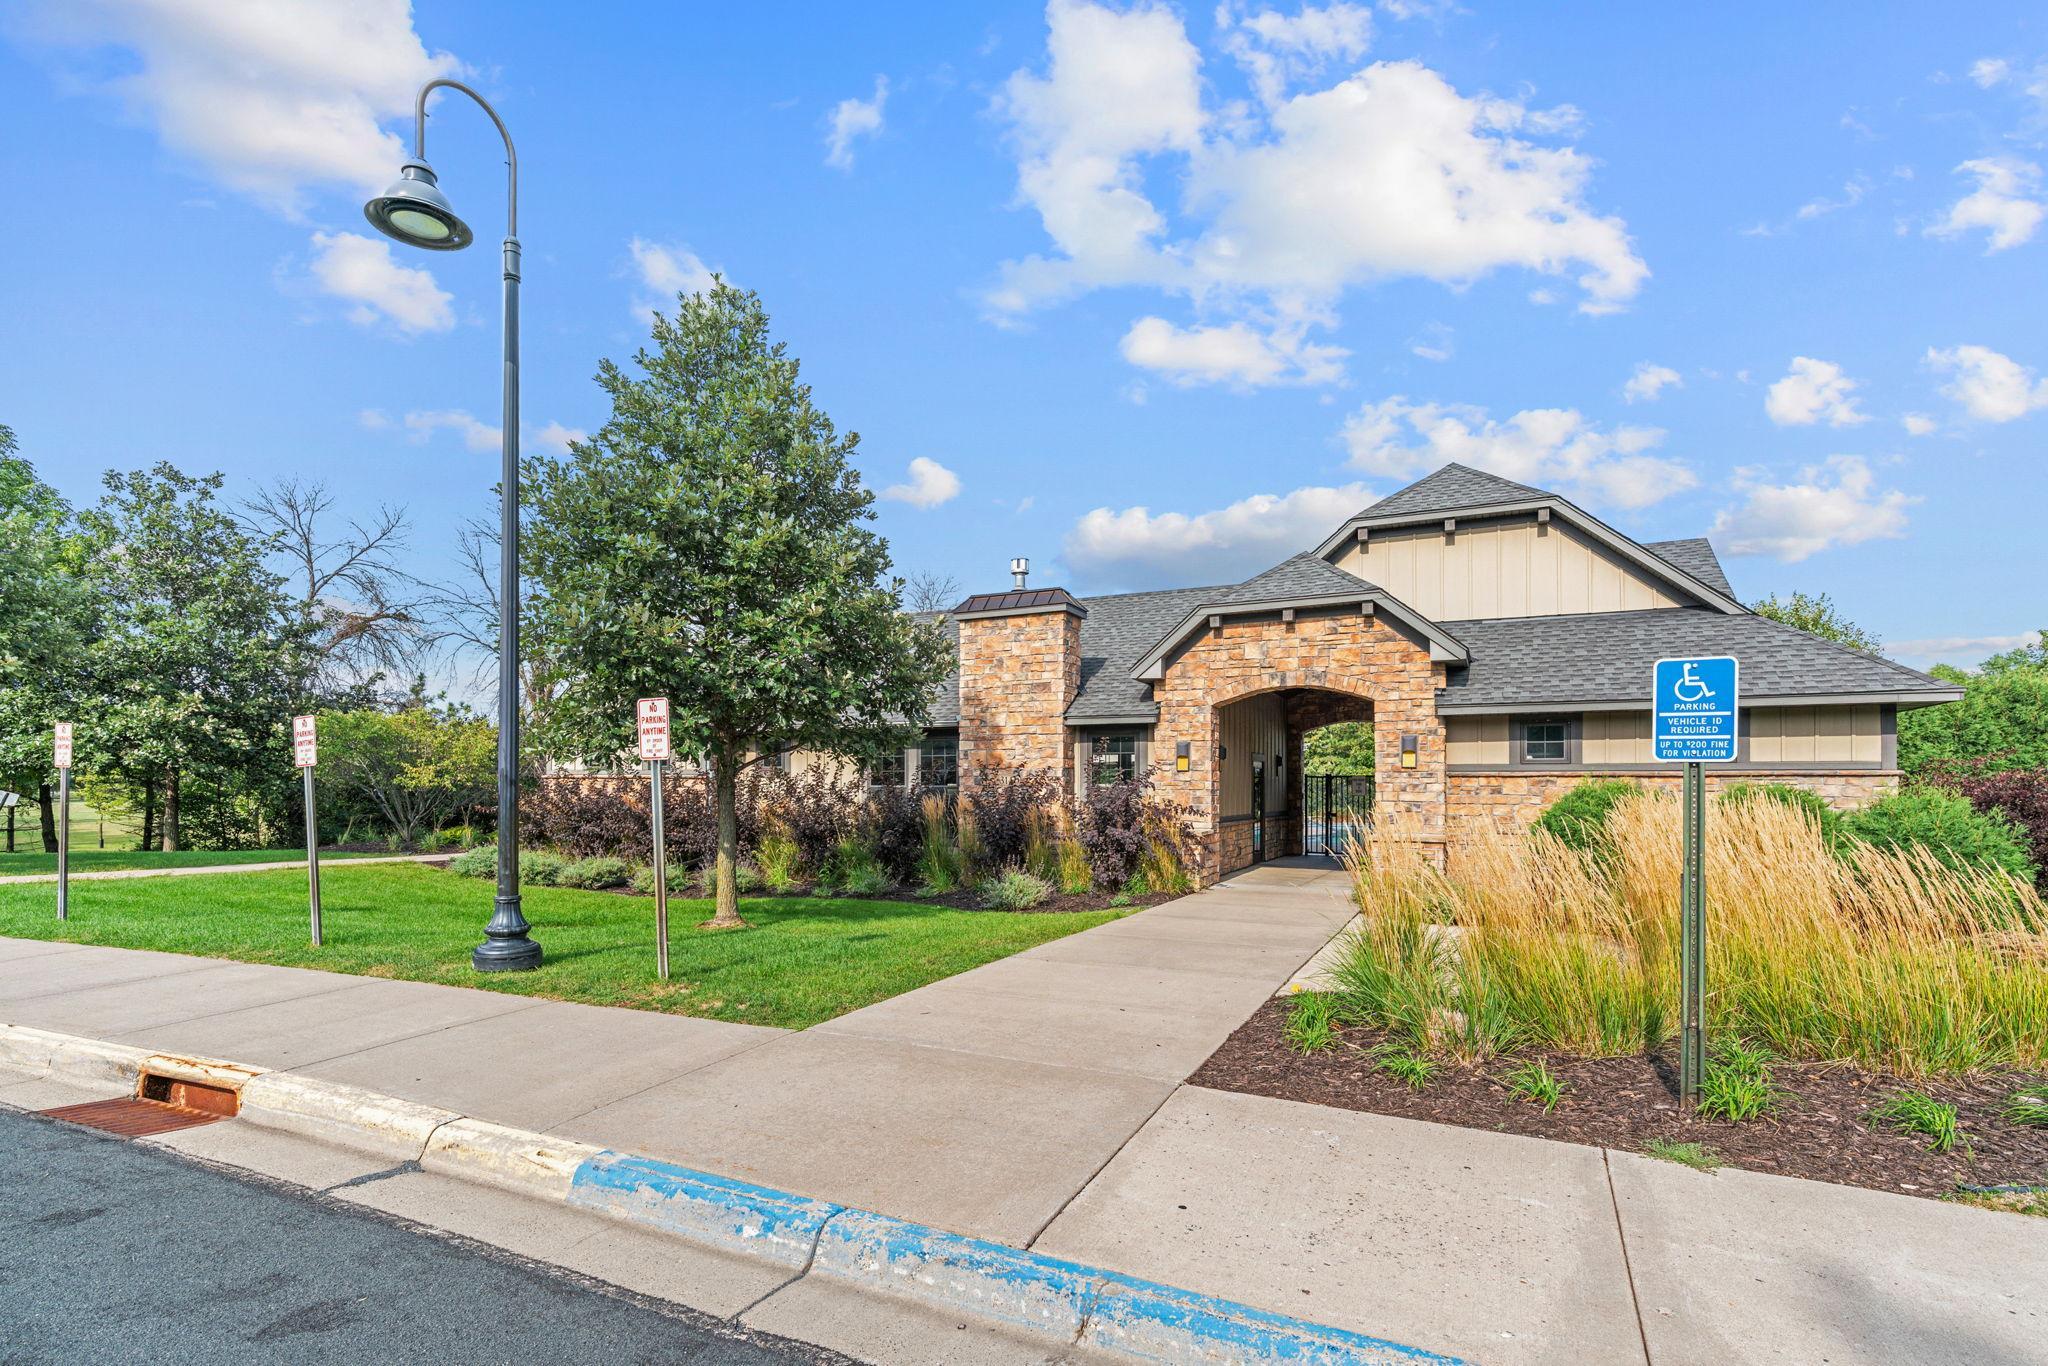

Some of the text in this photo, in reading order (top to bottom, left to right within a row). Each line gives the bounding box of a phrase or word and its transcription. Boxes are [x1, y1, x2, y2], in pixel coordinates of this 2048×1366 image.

[649, 704, 657, 713] NO
[1674, 702, 1716, 711] PARKING
[641, 715, 666, 724] PARKING
[1667, 717, 1722, 725] VEHICLE ID
[641, 727, 667, 736] ANYTIME
[1670, 726, 1719, 734] REQUIRED
[1711, 740, 1729, 748] FINE
[1663, 749, 1727, 757] FOR VIOLATION
